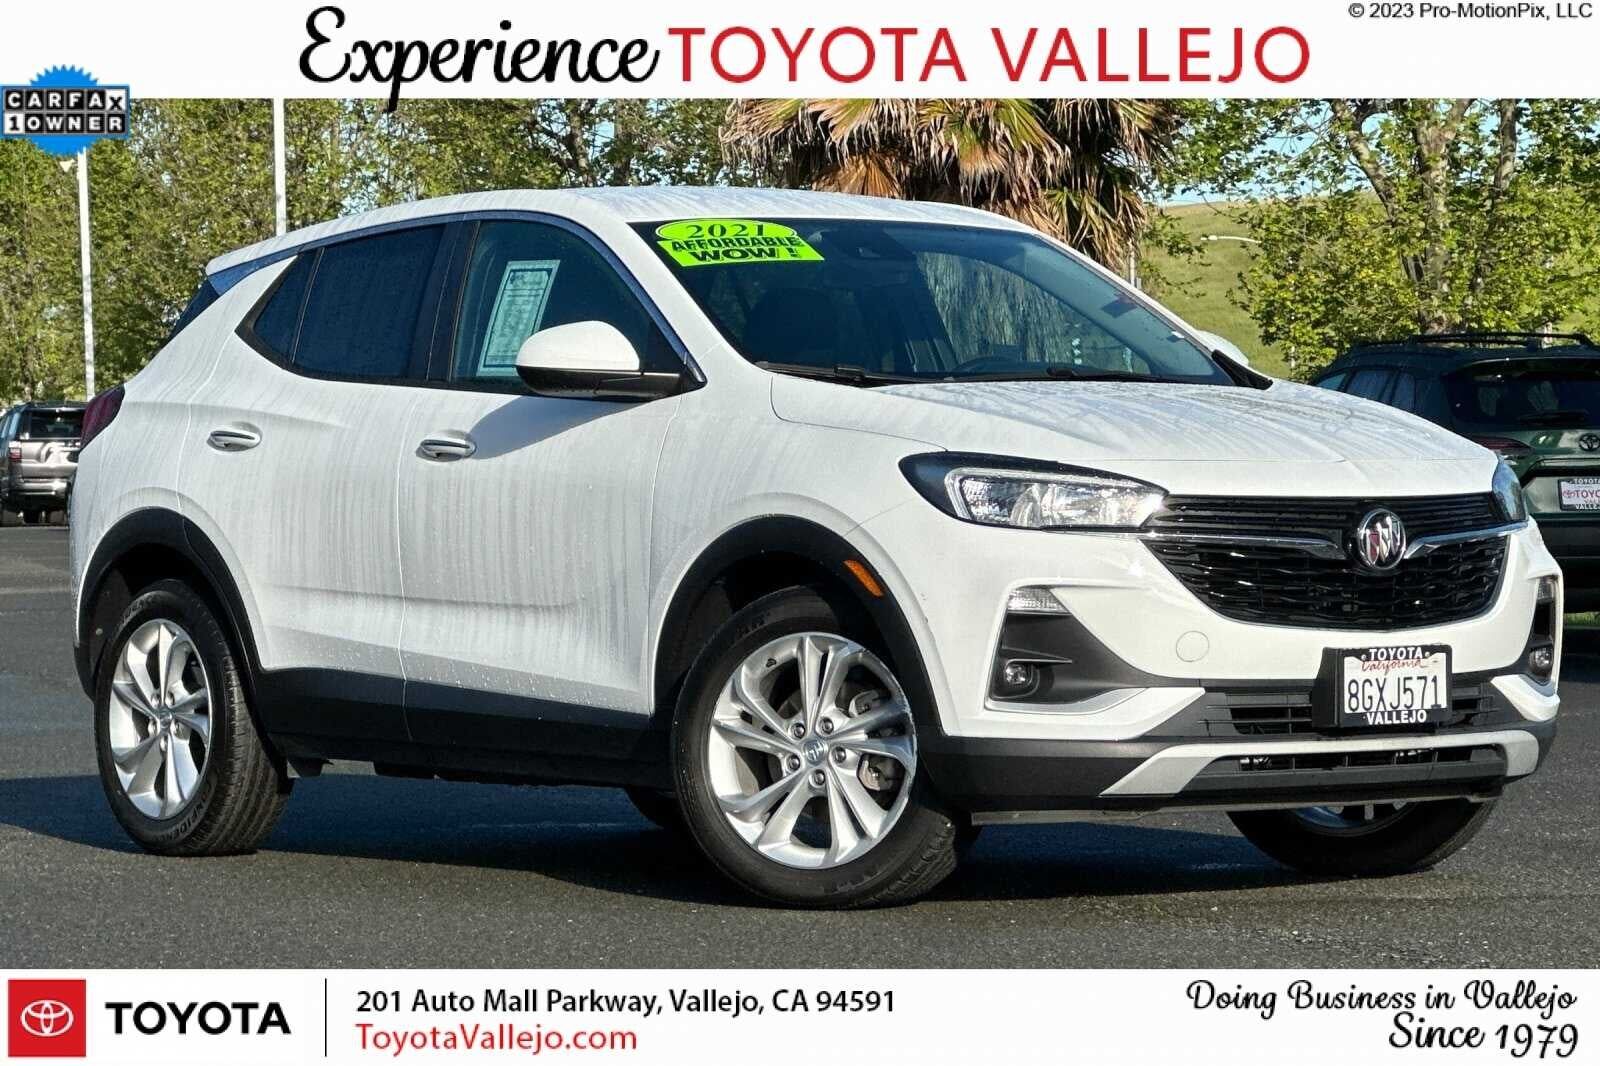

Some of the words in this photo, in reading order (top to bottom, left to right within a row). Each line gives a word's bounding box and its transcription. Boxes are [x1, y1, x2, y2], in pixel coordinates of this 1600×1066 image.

[686, 223, 766, 239] 2021
[671, 236, 804, 251] AFFORDABLE
[1369, 647, 1423, 660] TOYOTA
[1361, 659, 1426, 676] California
[1348, 675, 1441, 712] 8GXJ571
[1366, 709, 1427, 725] VALLEJO
